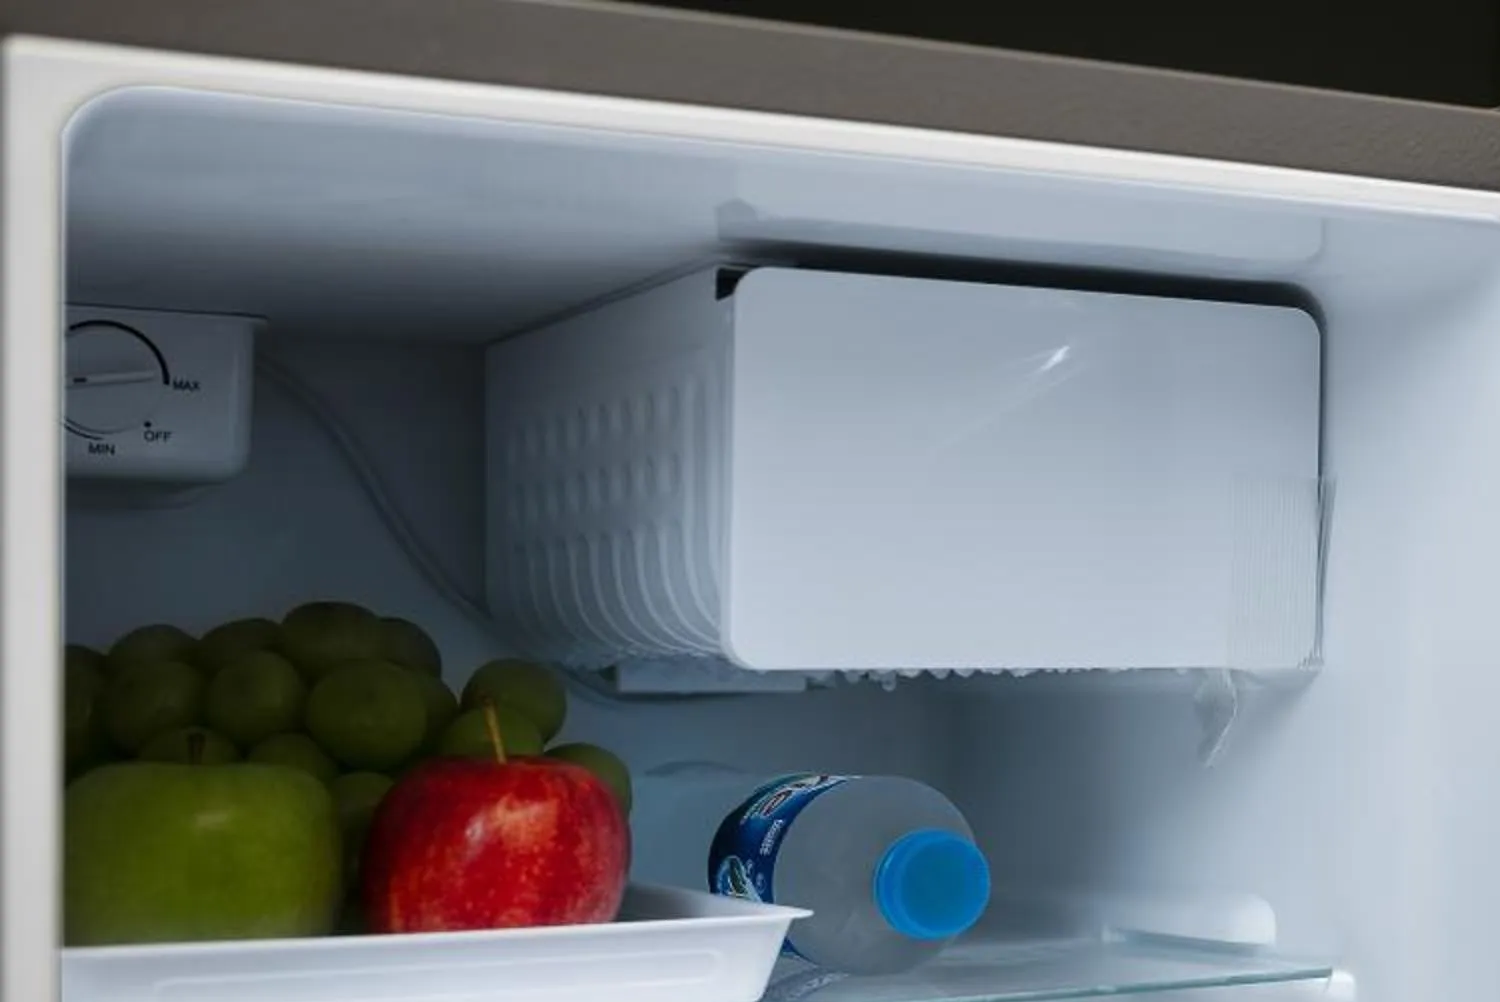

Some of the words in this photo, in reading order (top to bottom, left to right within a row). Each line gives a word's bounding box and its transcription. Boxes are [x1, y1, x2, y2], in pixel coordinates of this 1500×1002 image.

[172, 377, 201, 392] MAX
[143, 430, 172, 442] OFF
[88, 442, 116, 456] MIN
